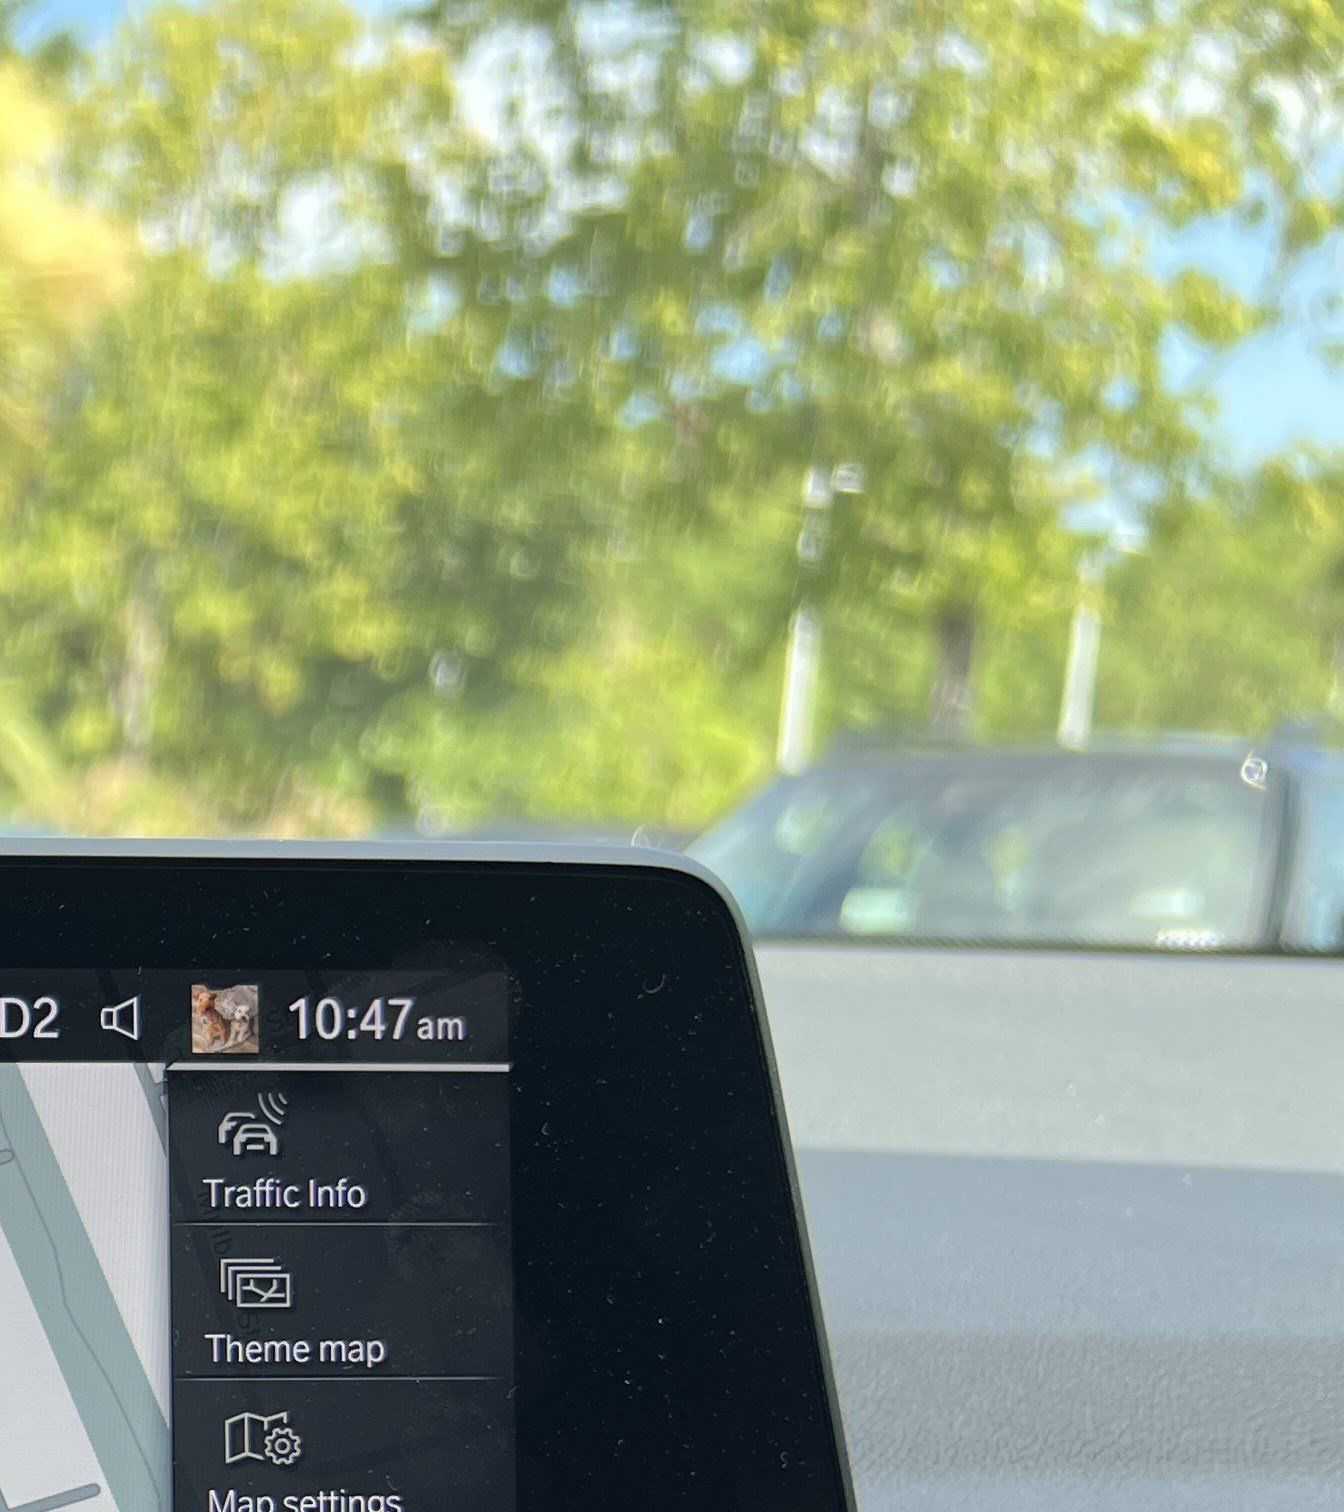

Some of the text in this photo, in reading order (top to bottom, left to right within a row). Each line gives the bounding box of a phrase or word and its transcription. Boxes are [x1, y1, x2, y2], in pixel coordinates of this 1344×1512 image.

[202, 1178, 367, 1209] Traffic Info
[204, 1333, 386, 1368] Theme map
